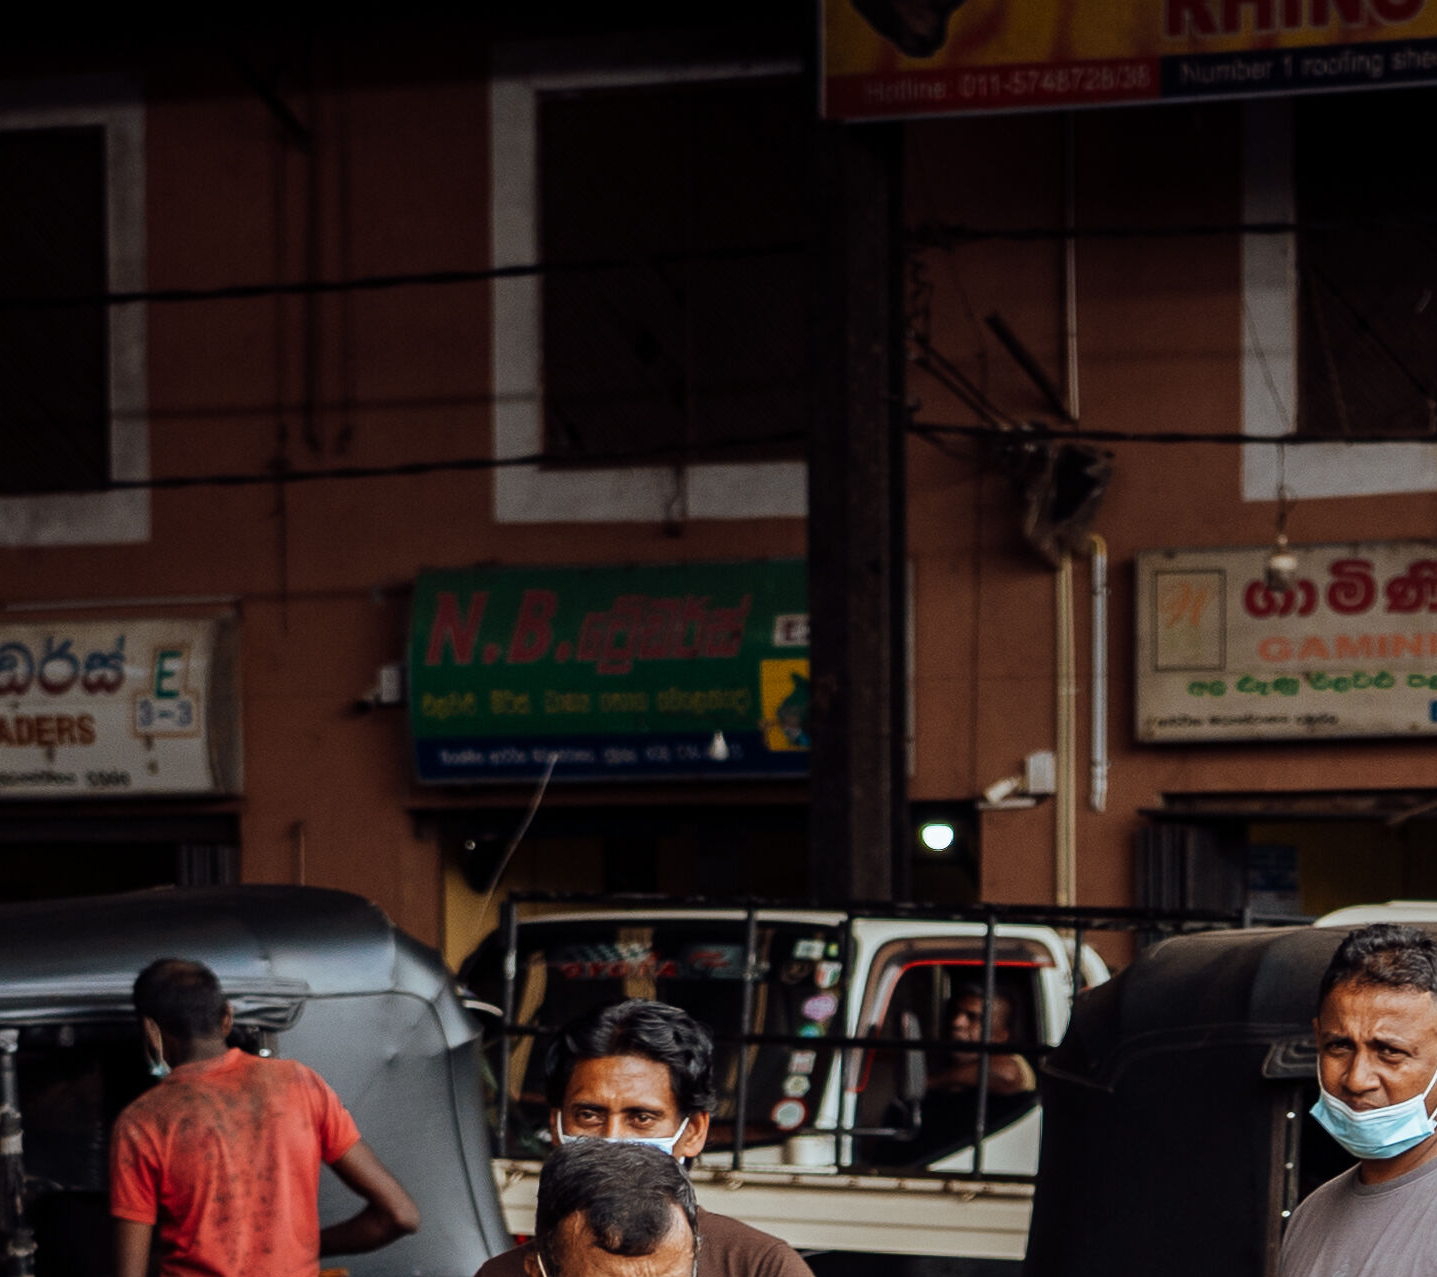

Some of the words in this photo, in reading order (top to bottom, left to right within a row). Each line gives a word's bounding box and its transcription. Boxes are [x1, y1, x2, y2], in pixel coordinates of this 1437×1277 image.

[1179, 55, 1274, 85] Number
[1281, 54, 1293, 79] 1
[1300, 46, 1385, 80] roofing
[155, 650, 183, 699] E
